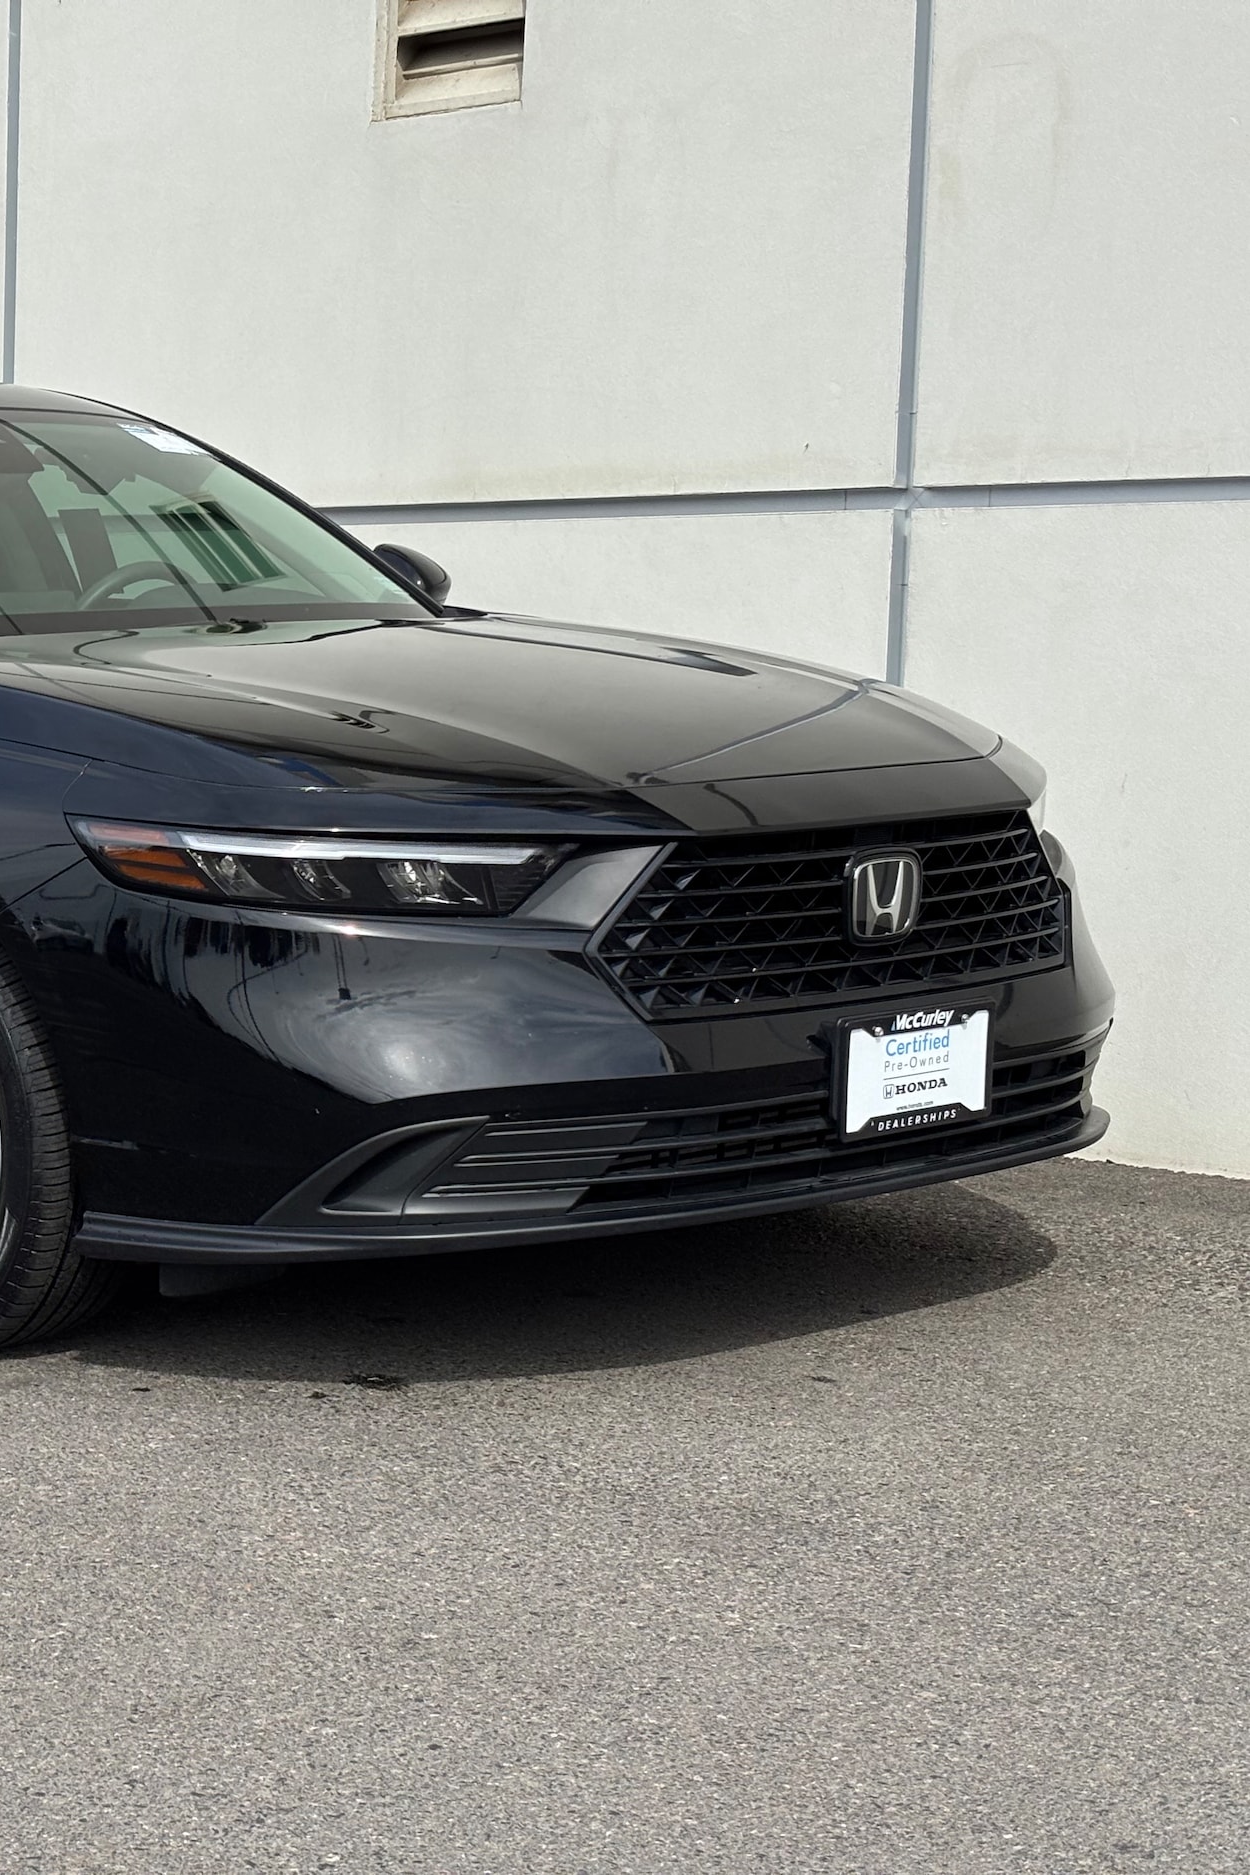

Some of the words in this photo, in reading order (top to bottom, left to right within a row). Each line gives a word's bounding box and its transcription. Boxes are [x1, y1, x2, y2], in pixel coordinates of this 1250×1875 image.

[893, 1009, 955, 1031] McCurley
[885, 1030, 950, 1057] Certified
[884, 1051, 950, 1073] Pre-Owned
[895, 1077, 948, 1096] HONDA
[877, 1108, 957, 1132] DEALERSHIPS
